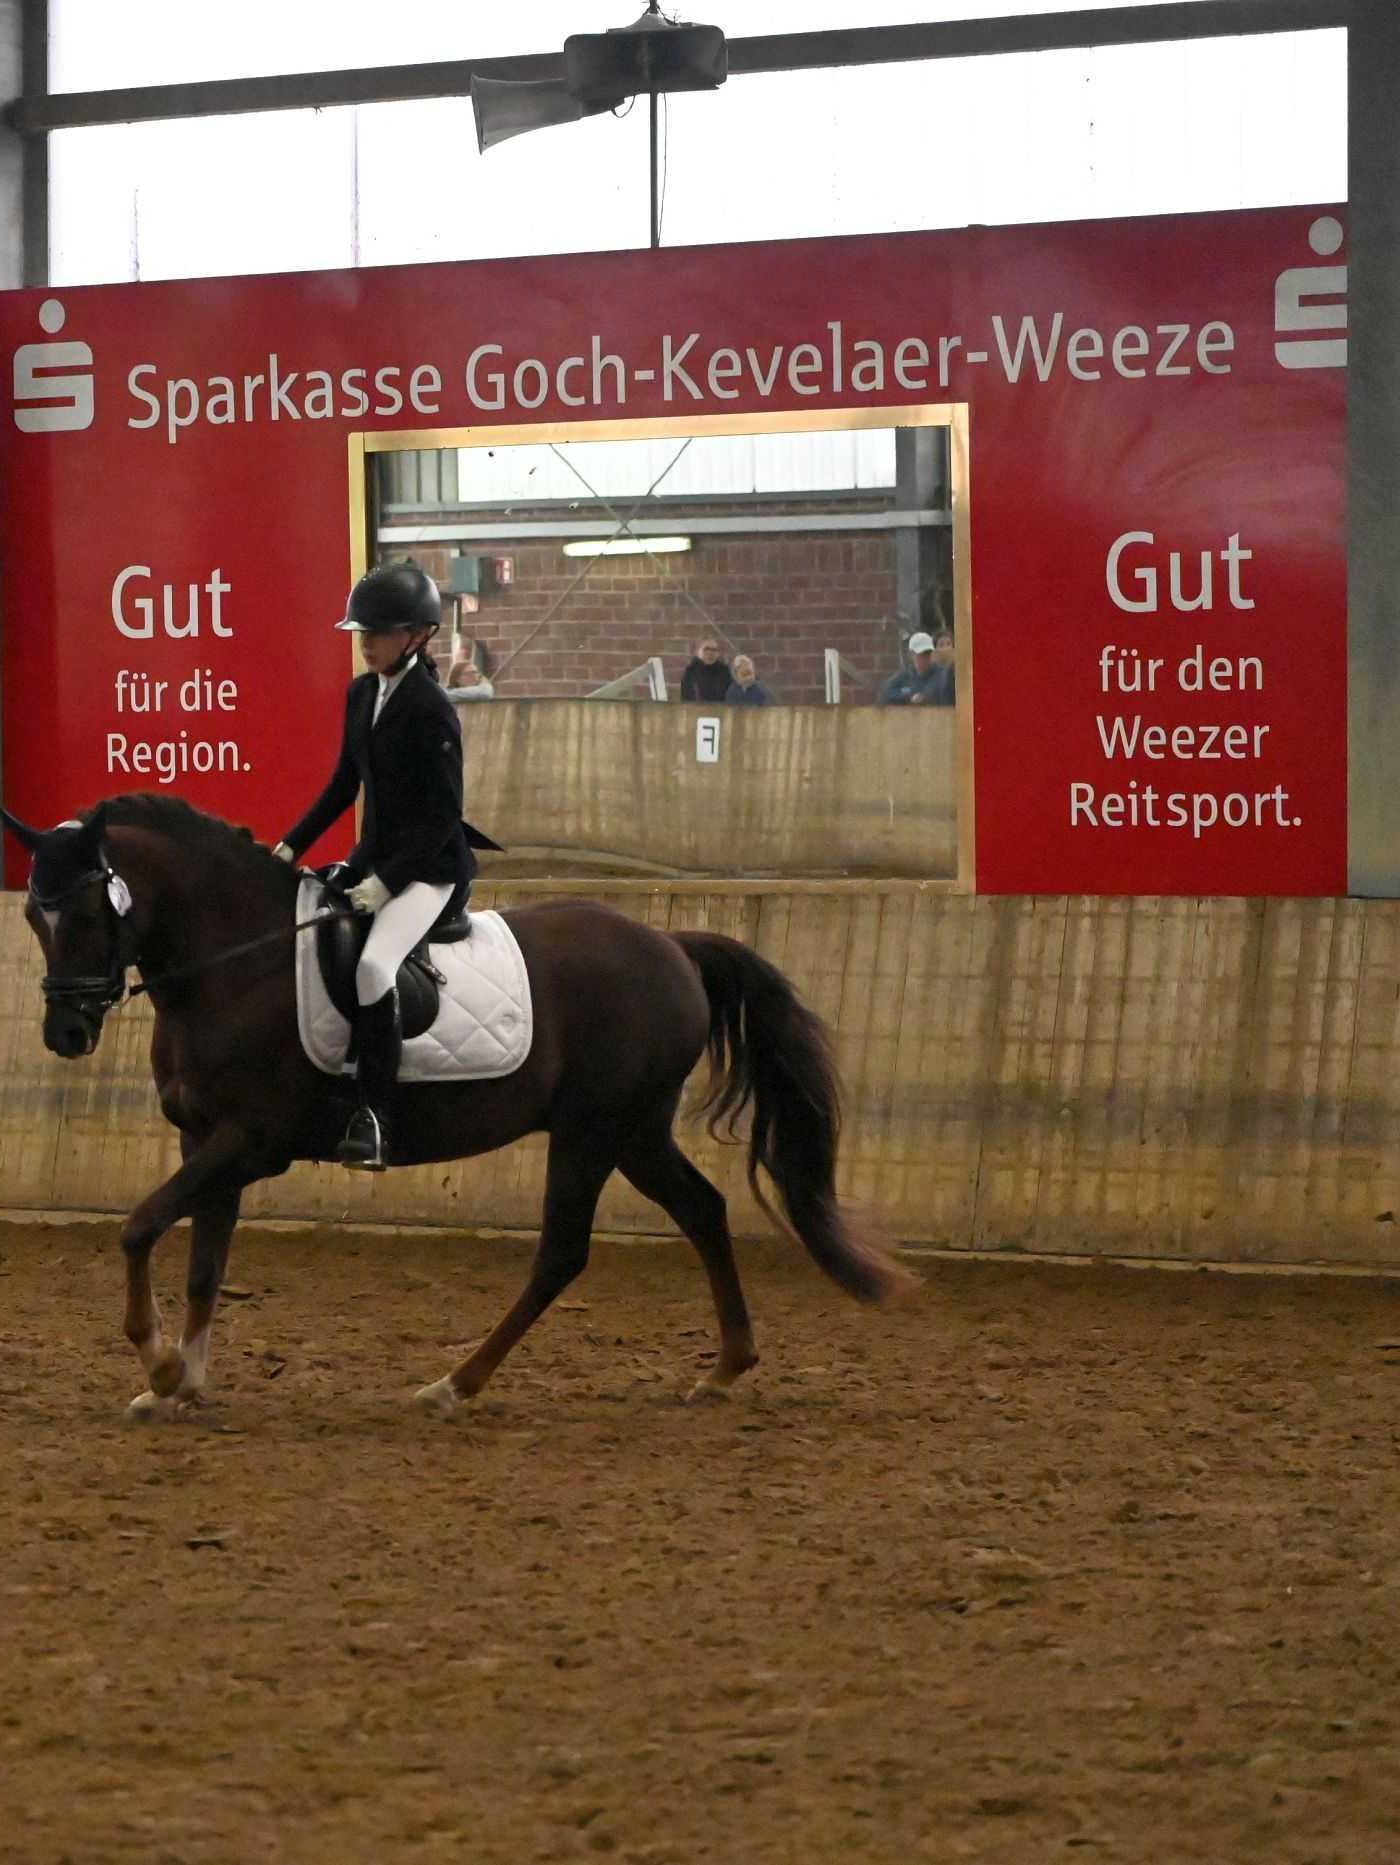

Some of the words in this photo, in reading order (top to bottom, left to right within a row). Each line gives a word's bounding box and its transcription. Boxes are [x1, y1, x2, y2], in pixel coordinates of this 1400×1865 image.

[127, 352, 443, 445] Sparkasse
[465, 311, 1235, 411] Goch-Kevelaer-Weeze
[1105, 531, 1255, 613] Gut
[111, 566, 234, 639] Gut
[115, 670, 168, 712] für
[179, 668, 237, 711] die
[1099, 647, 1163, 692] für
[1178, 645, 1263, 691] den
[107, 730, 251, 784] Region.
[1096, 714, 1270, 760] Weezer
[1070, 781, 1303, 838] Reitsport.
